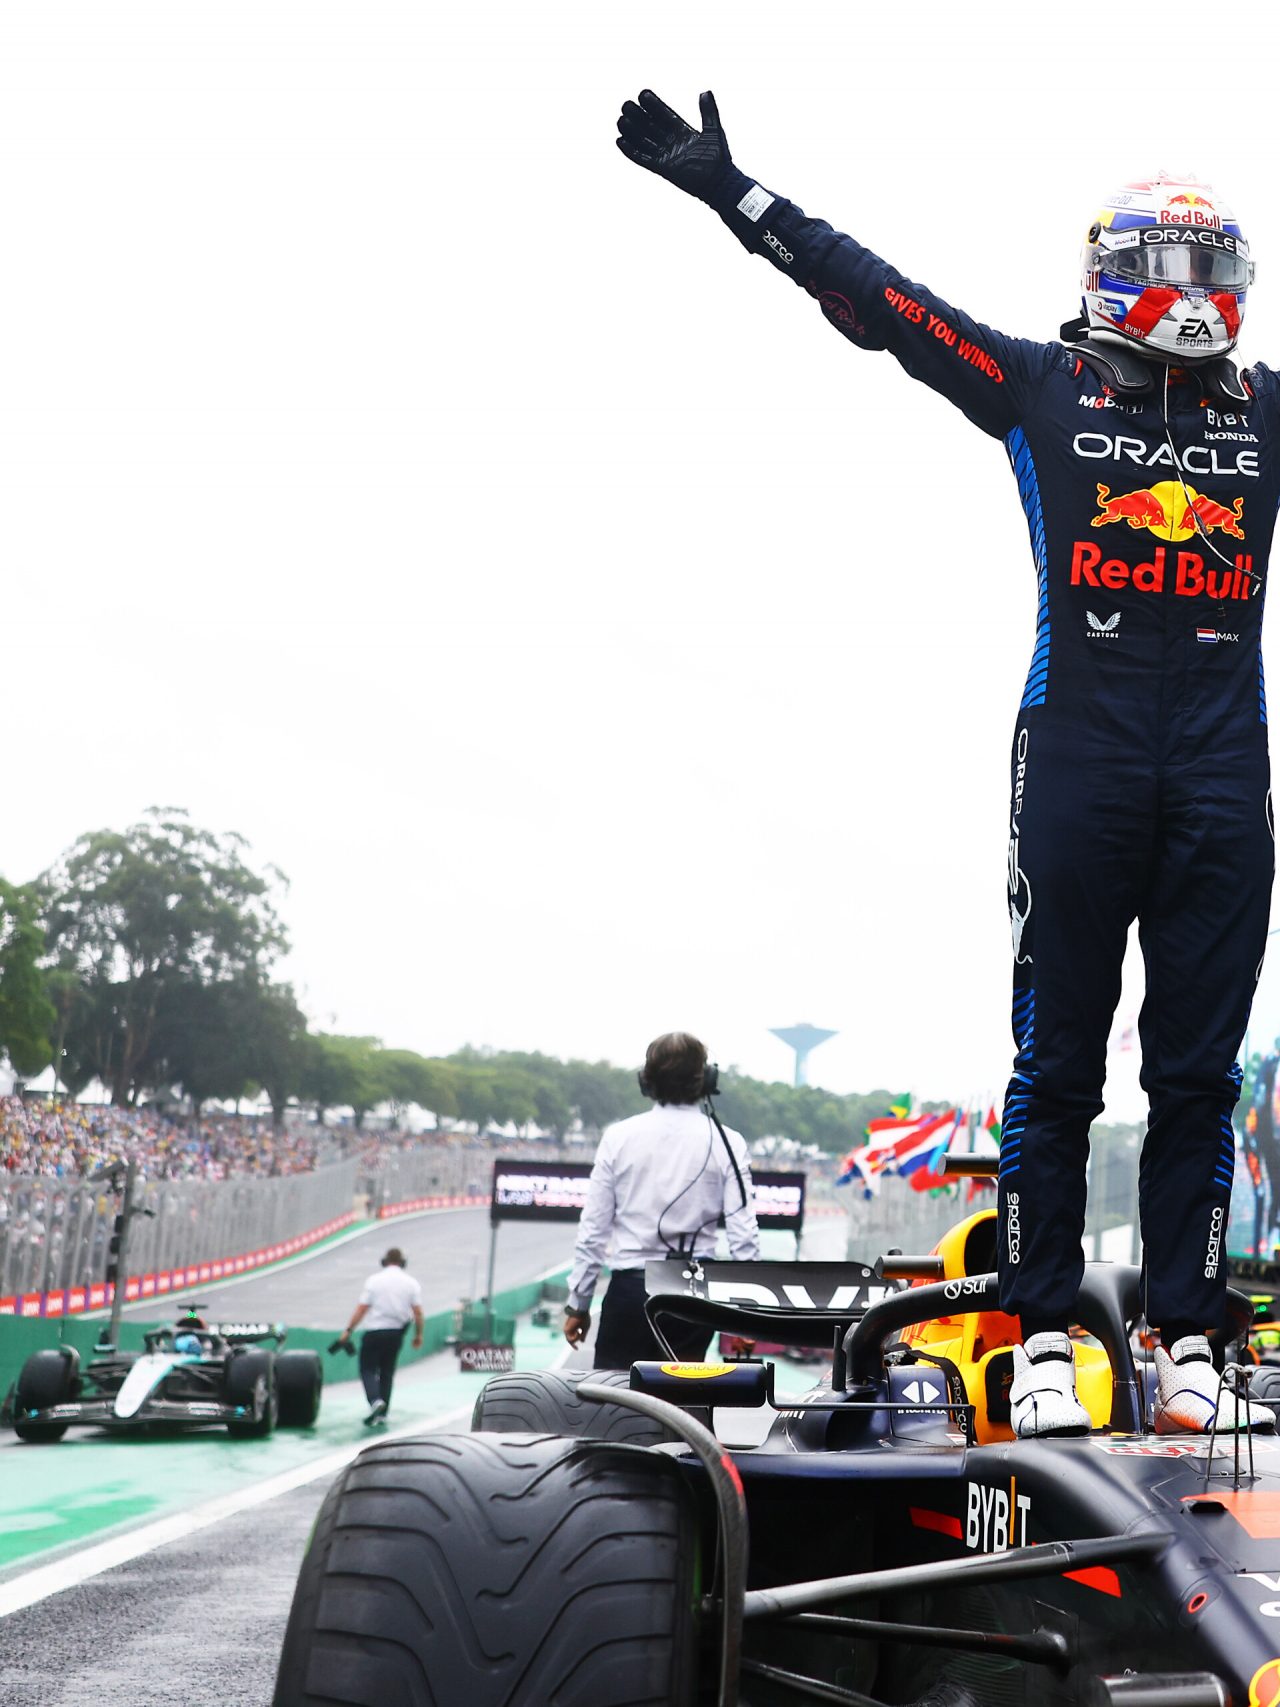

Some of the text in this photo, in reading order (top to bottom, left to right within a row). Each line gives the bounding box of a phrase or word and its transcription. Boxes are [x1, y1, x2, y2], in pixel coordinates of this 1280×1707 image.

[1160, 210, 1221, 229] Red Bull
[1143, 229, 1235, 251] ORACLE
[1085, 271, 1099, 293] ull
[884, 287, 1005, 384] GIVES YOU WINGS
[1124, 323, 1145, 339] BYBIT
[1177, 318, 1213, 338] EA
[1175, 337, 1213, 348] SPORTS
[1078, 394, 1124, 412] Mob
[1207, 408, 1249, 428] BYBIT
[1204, 430, 1260, 443] HONDA
[1072, 432, 1260, 477] ORACLE
[1070, 541, 1253, 600] Red Bull
[1086, 631, 1120, 639] CASTORE
[1217, 632, 1240, 642] MAX
[1007, 1192, 1020, 1264] sparco
[1204, 1207, 1224, 1279] sparco
[963, 1277, 989, 1295] Sui
[966, 1476, 1031, 1553] BYBIT
